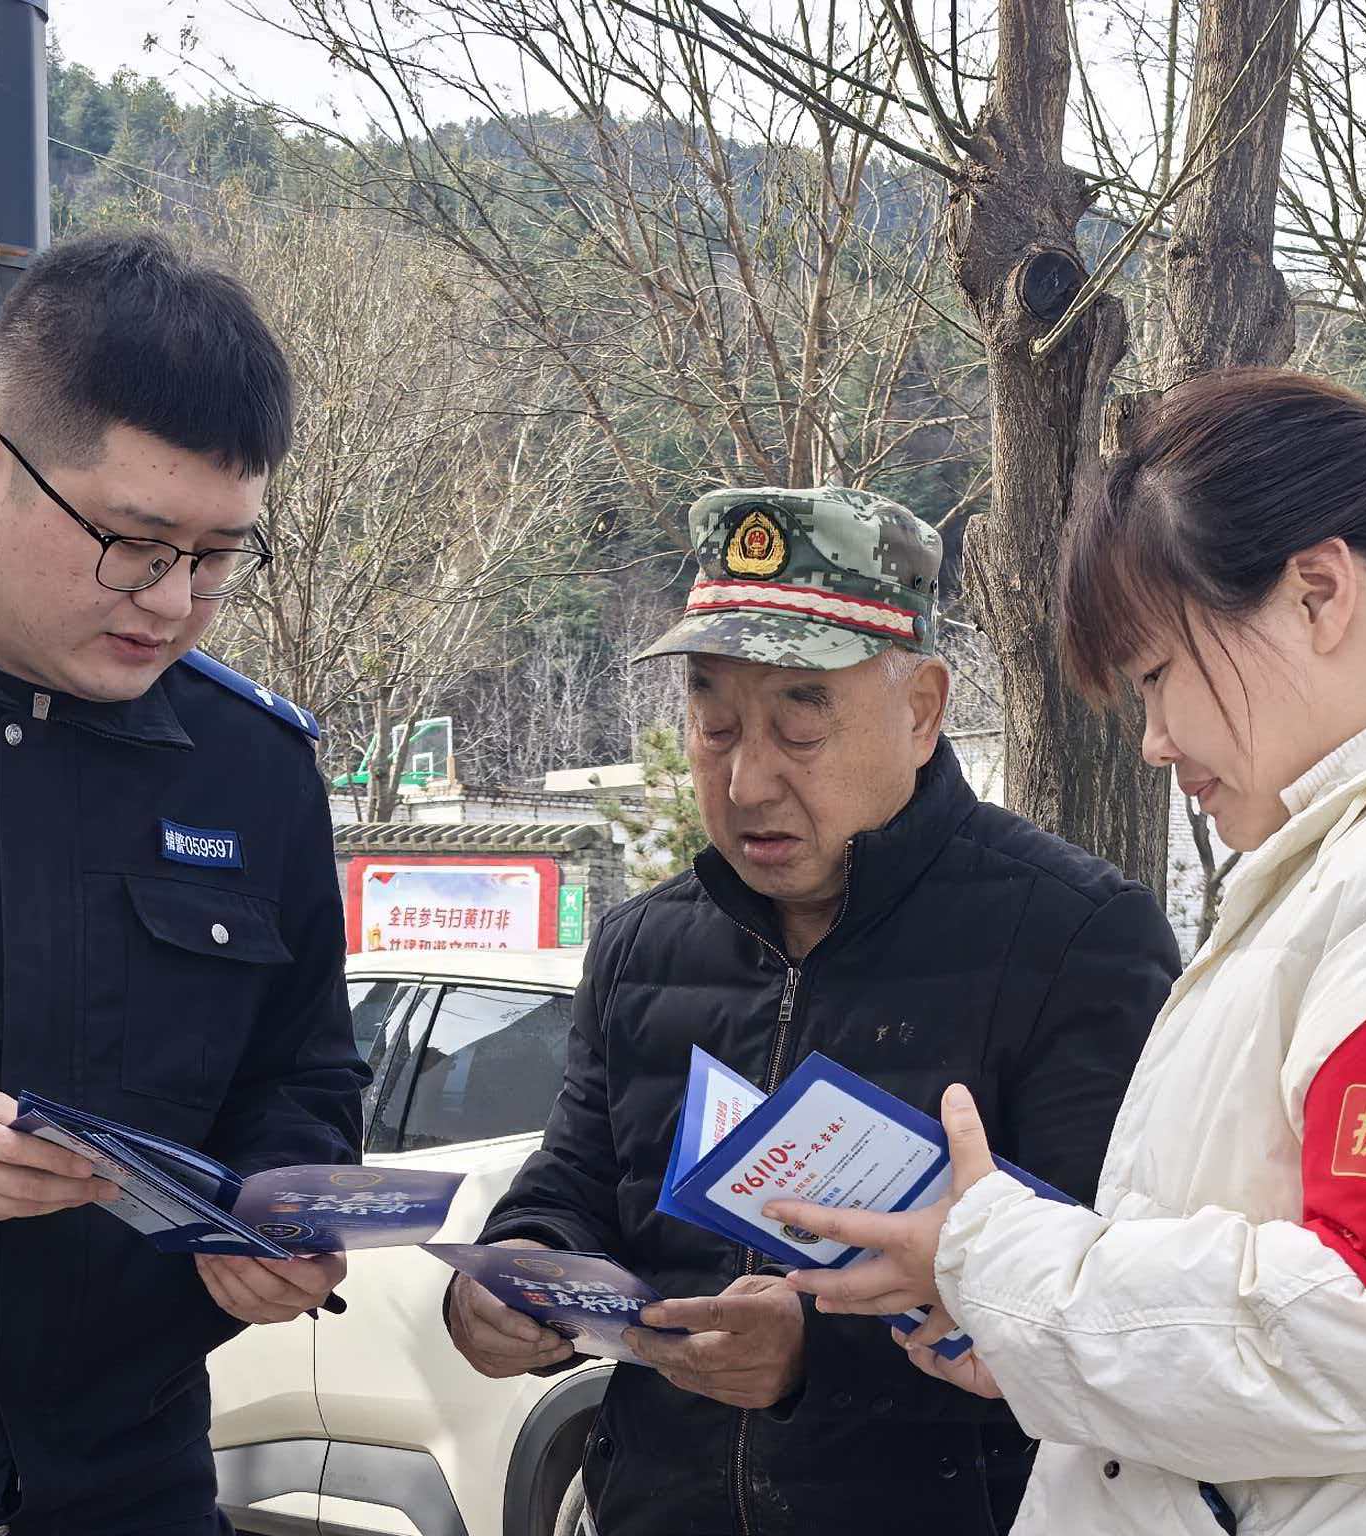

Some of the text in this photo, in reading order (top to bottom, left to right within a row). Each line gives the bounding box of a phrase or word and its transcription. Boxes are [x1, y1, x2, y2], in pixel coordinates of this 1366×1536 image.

[388, 905, 511, 930] 全民参与扫黄打非
[730, 1147, 788, 1196] 96110
